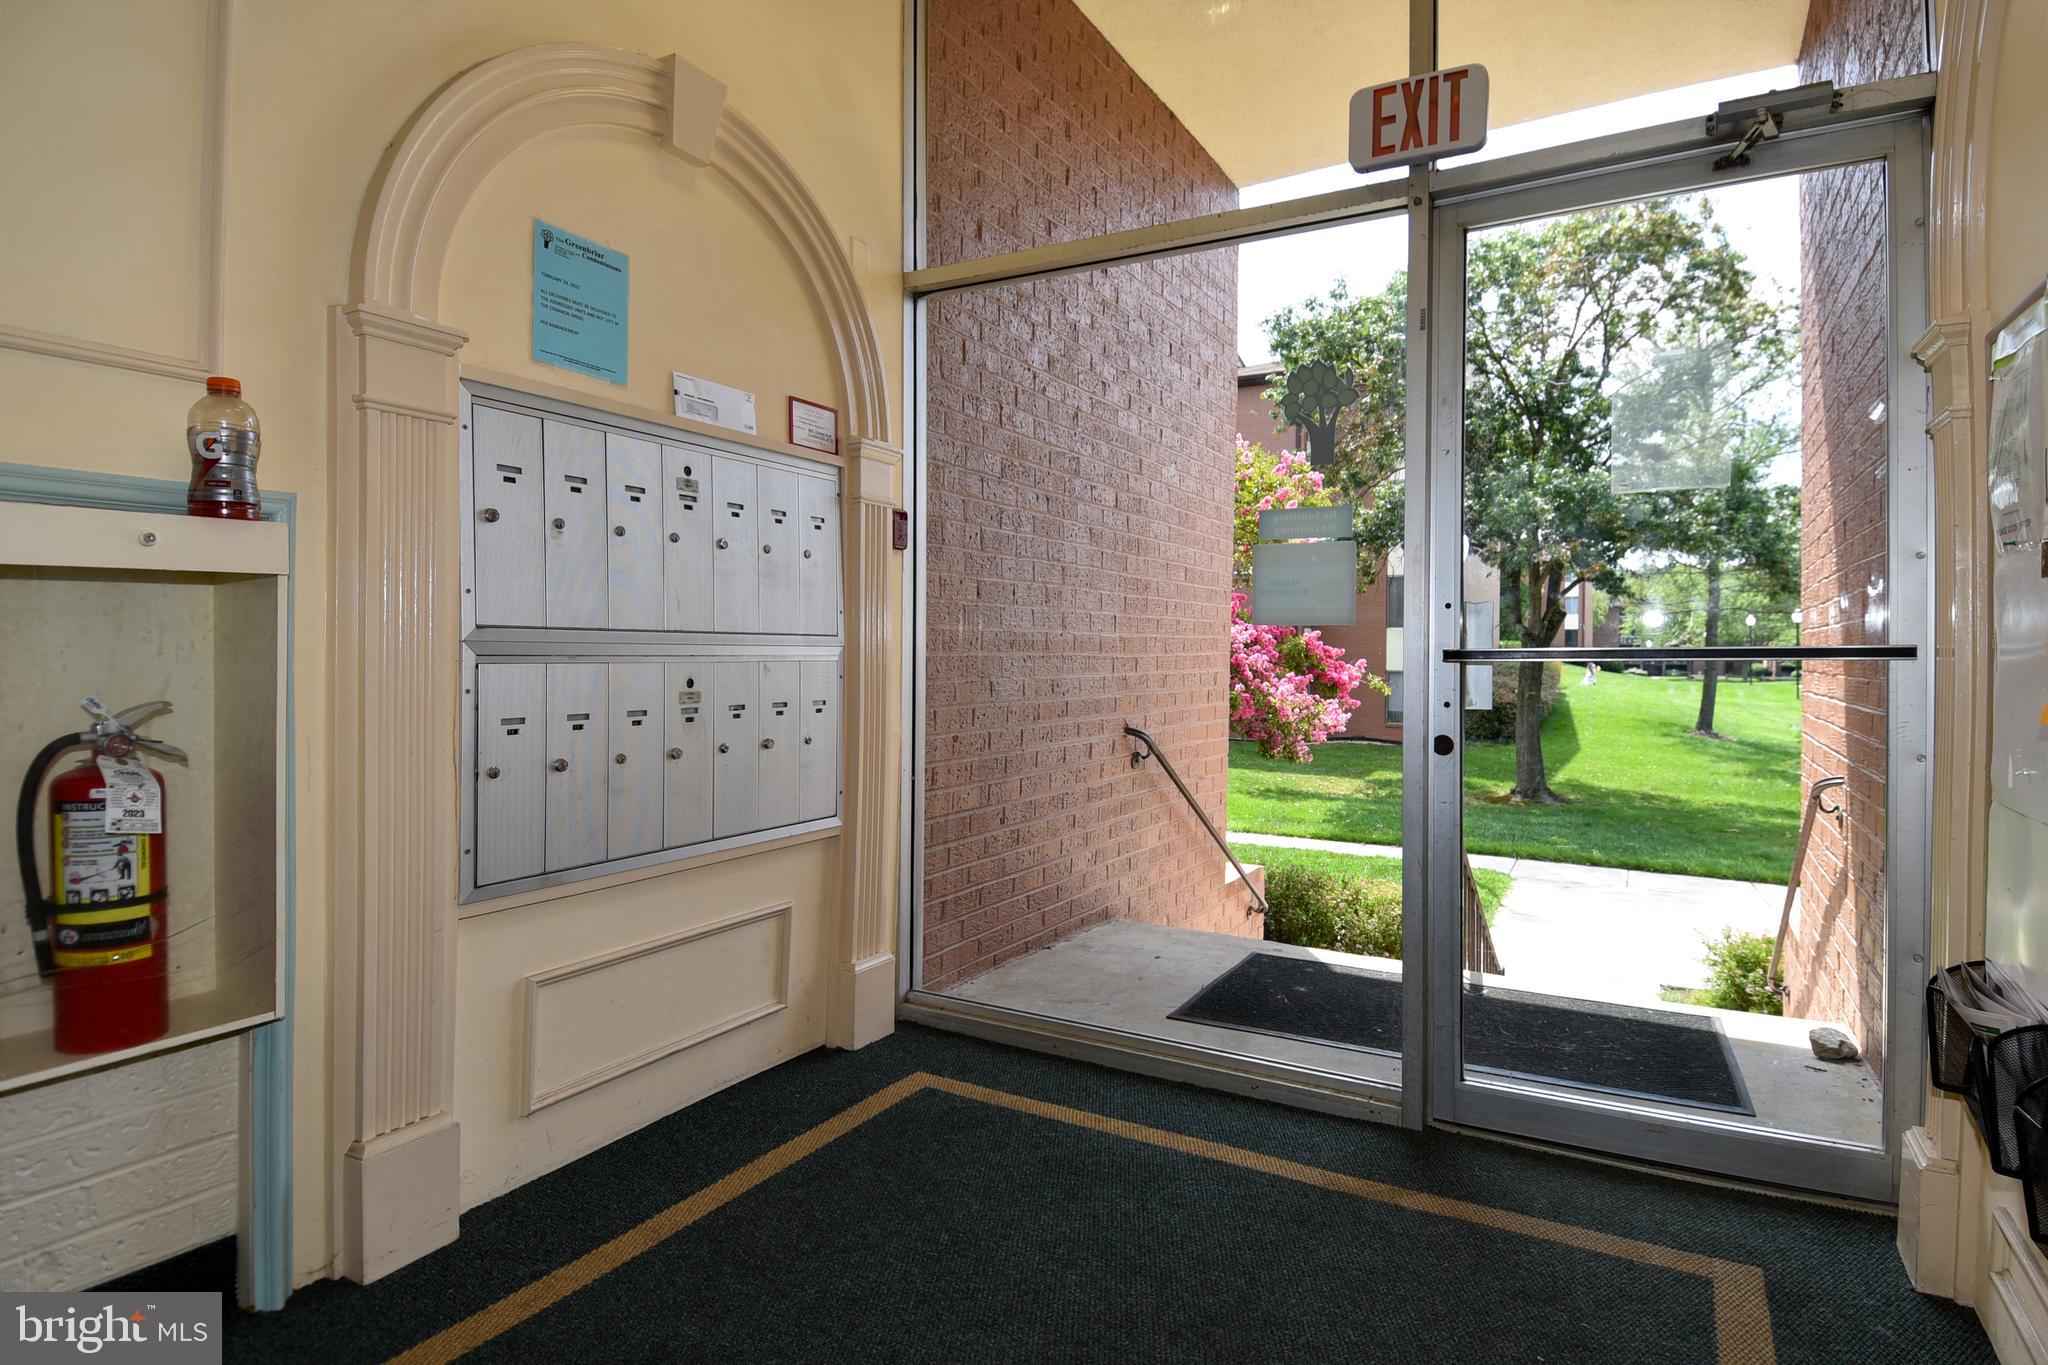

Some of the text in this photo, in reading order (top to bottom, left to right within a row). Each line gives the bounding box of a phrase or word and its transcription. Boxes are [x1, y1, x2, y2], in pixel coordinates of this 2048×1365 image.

[1372, 69, 1468, 158] EXIT
[565, 238, 605, 259] Greenbriar
[540, 302, 548, 310] THE
[549, 305, 570, 317] COMMON
[596, 314, 605, 322] NOT
[549, 322, 580, 336] MANAGEMENT
[196, 432, 223, 460] G
[122, 809, 145, 818] 2023
